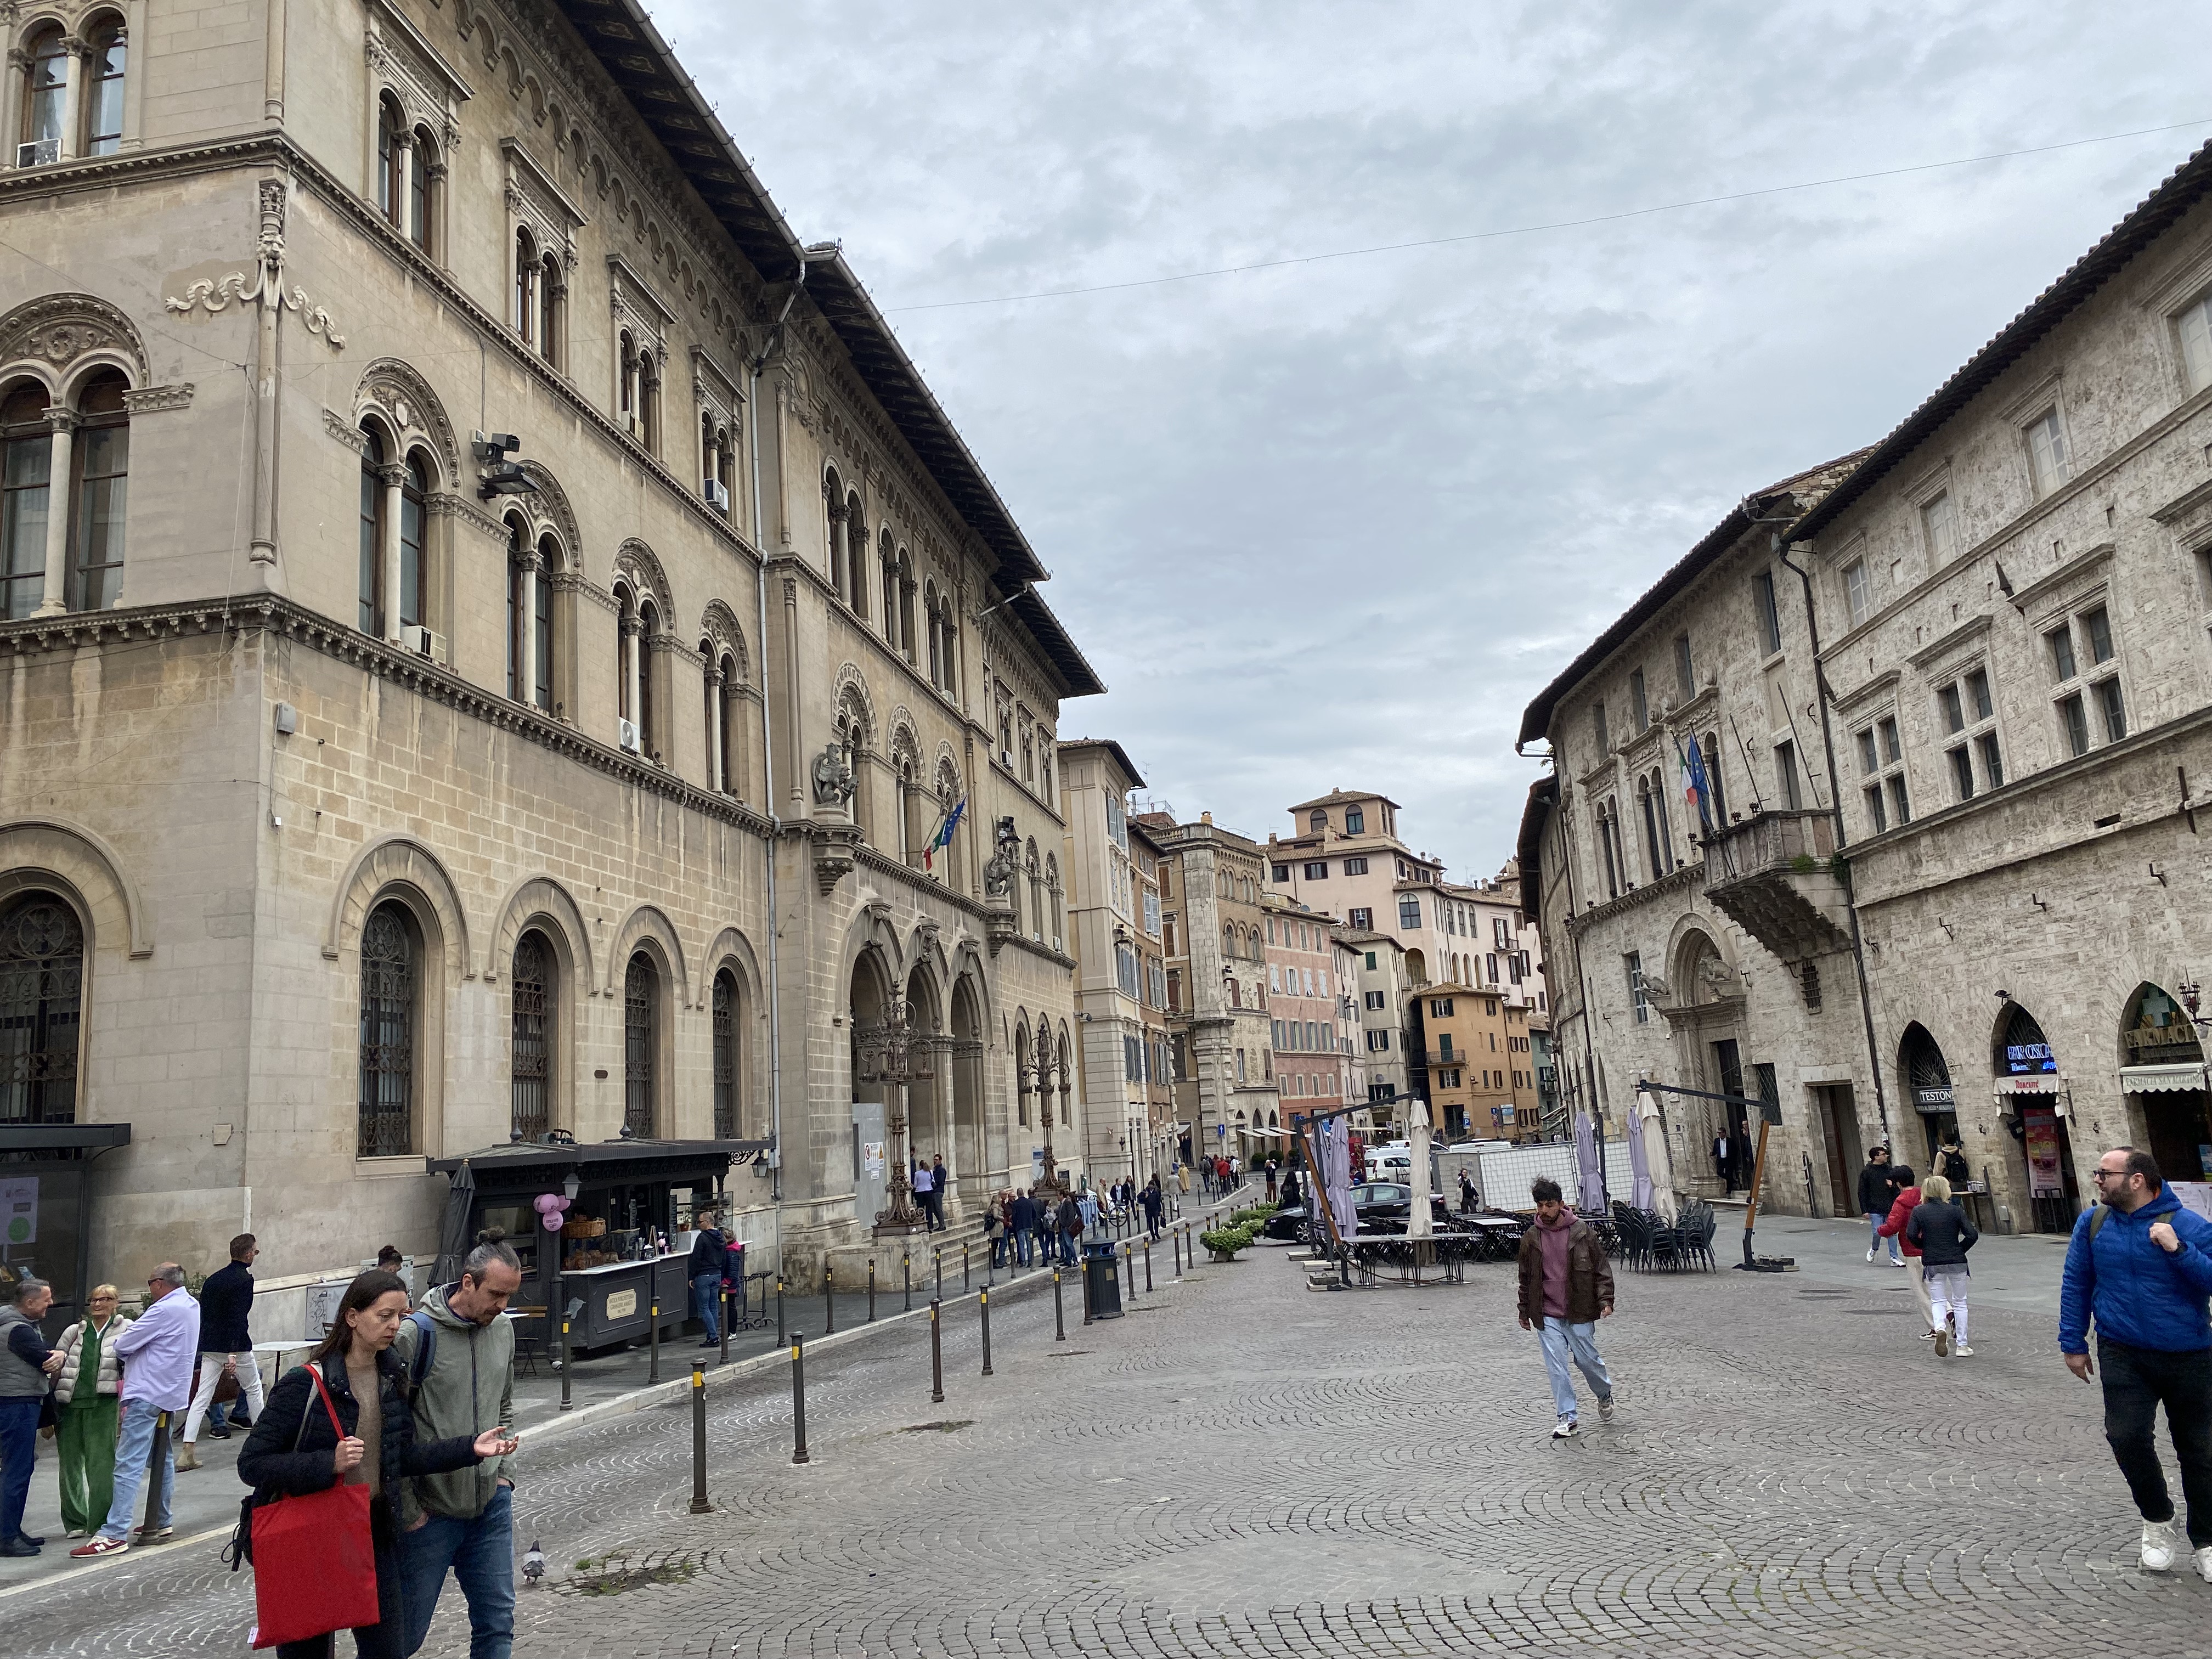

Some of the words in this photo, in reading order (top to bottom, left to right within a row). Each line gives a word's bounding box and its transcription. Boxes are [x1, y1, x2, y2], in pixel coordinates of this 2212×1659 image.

[2008, 1045, 2025, 1060] BAR
[2025, 1043, 2053, 1059] OSCA
[2125, 1077, 2157, 1086] FARMACIA
[2158, 1076, 2171, 1085] SAN
[2172, 1074, 2203, 1084] MARTINO
